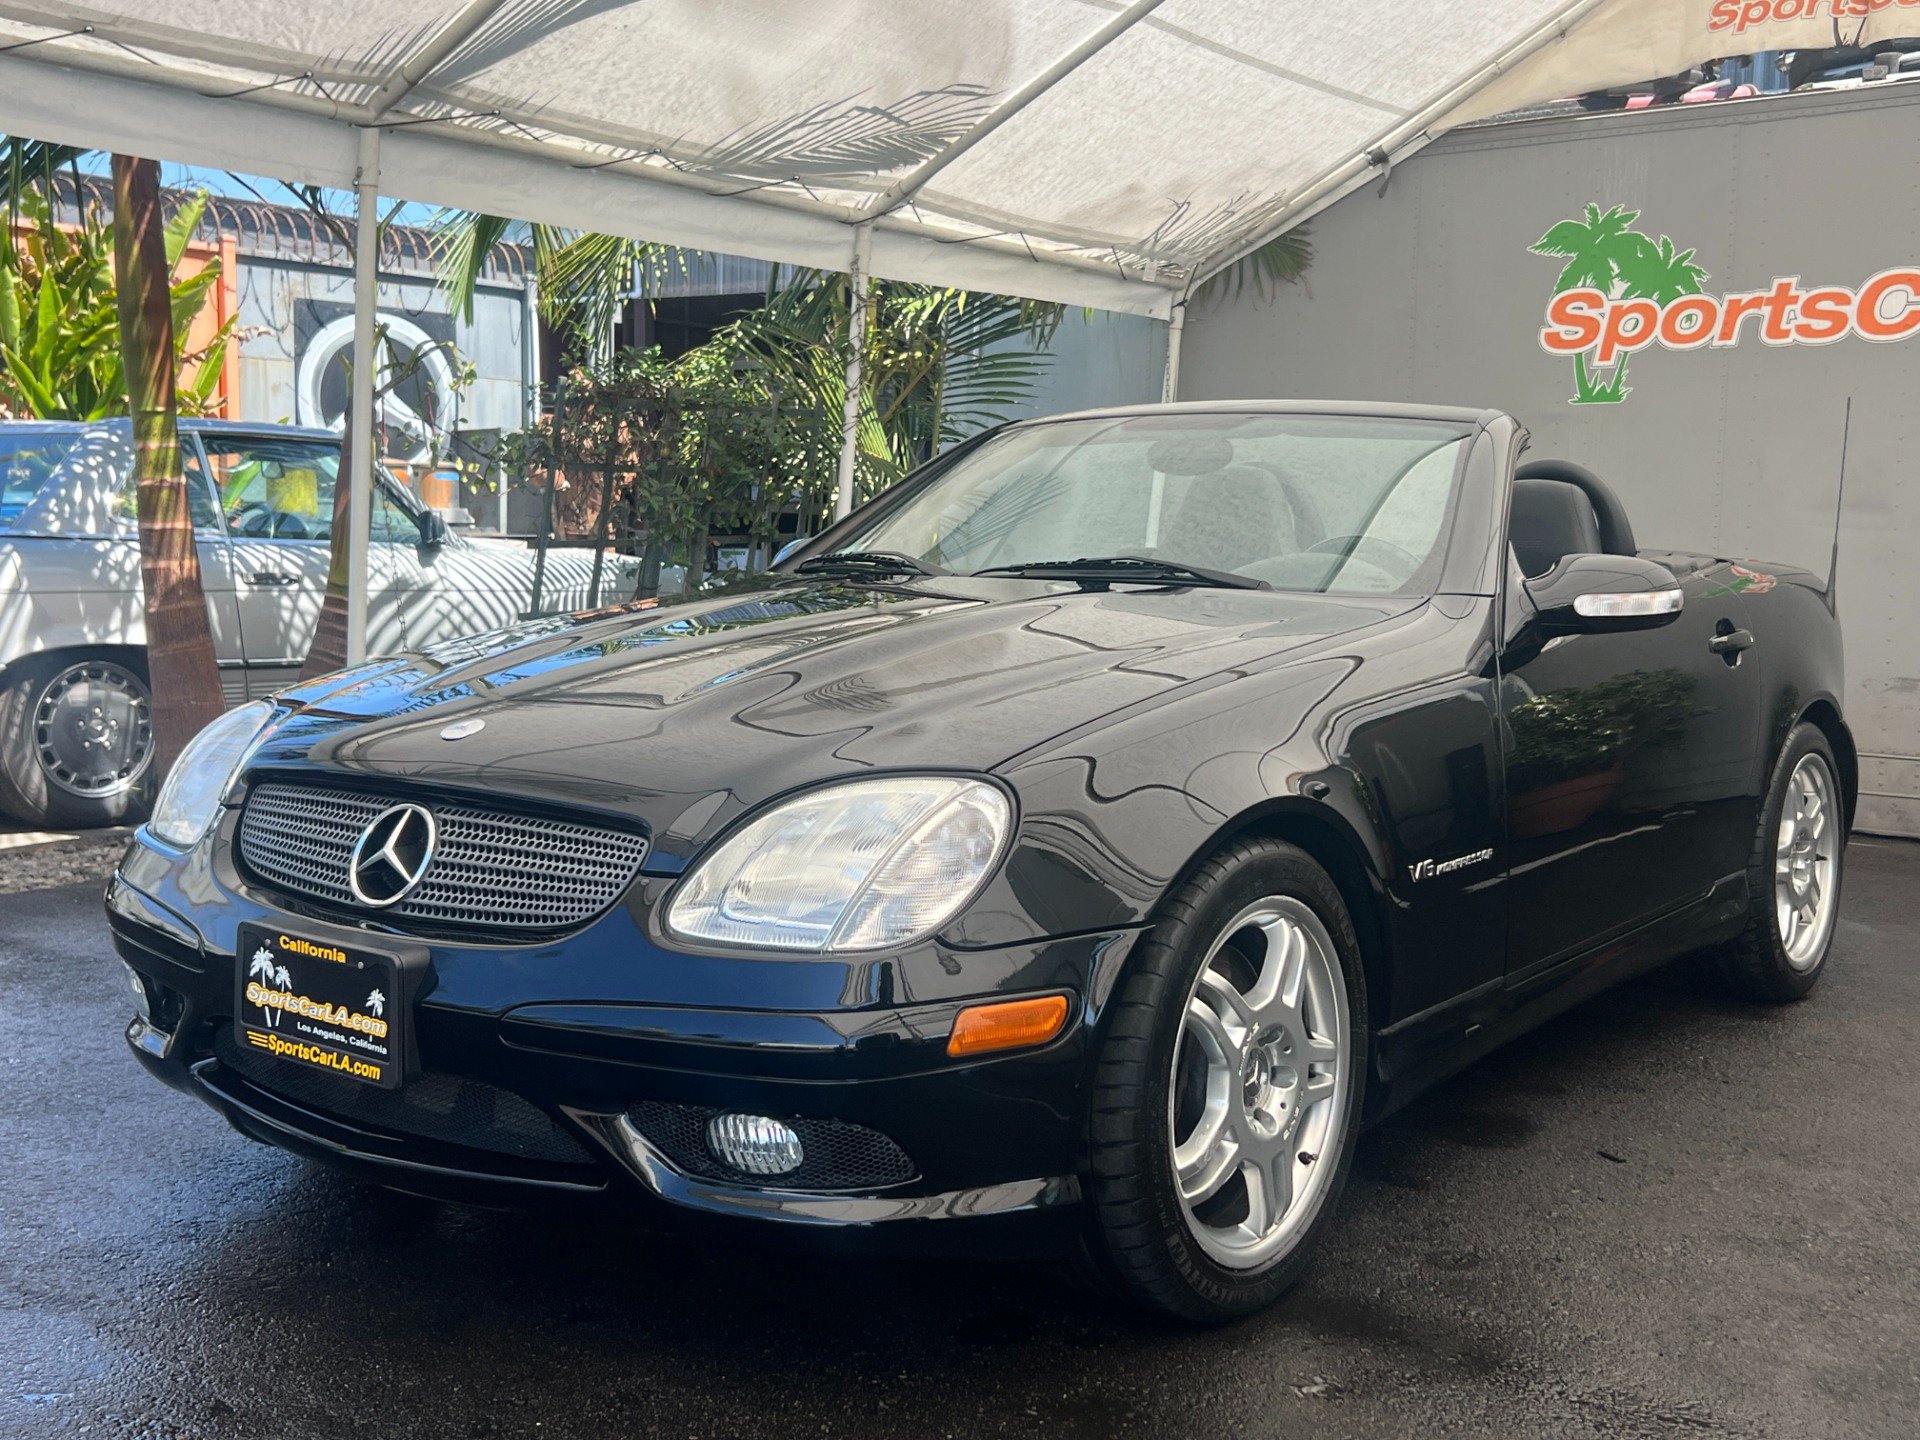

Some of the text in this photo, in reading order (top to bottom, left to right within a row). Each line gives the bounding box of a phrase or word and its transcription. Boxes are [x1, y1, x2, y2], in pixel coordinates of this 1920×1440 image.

[1708, 0, 1920, 32] Sports
[1542, 268, 1920, 364] SportsC
[1407, 859, 1434, 882] V6
[279, 935, 347, 964] California
[247, 982, 388, 1037] SportsCarLA.com
[297, 1021, 388, 1055] Los Angeles, California
[268, 1034, 381, 1081] SportsCarLA.com
